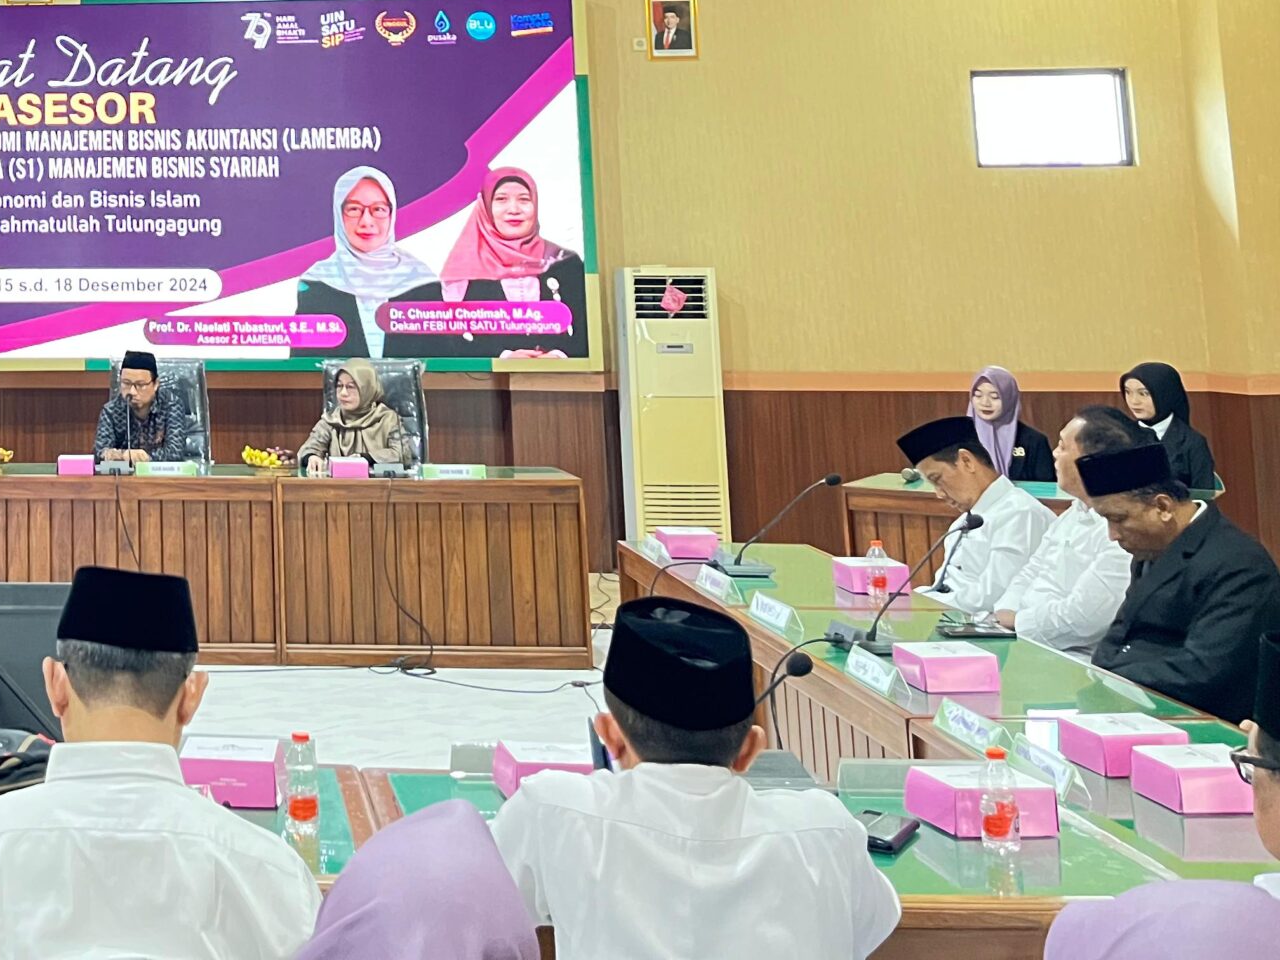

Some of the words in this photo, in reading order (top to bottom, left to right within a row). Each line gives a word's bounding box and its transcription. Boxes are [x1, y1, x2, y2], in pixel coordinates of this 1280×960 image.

[320, 10, 345, 25] UIN
[469, 19, 493, 29] BLU
[321, 19, 356, 37] SATU
[321, 33, 345, 49] SIP
[427, 32, 458, 42] pusaka
[47, 35, 238, 105] Datang
[25, 129, 122, 152] MANAJEMEN
[127, 128, 182, 151] BISNIS
[185, 128, 278, 151] AKUNTANSI
[282, 126, 381, 152] (LAMEMBA)
[8, 157, 45, 182] (S1)
[48, 156, 147, 179] MANAJEMEN
[151, 156, 206, 178] BISNIS
[209, 155, 280, 178] SYARIAH
[51, 190, 85, 208] dan
[89, 190, 145, 208] Bisnis
[150, 190, 201, 208] Islam
[104, 215, 222, 237] Tulungagung
[19, 278, 48, 292] s.d.
[54, 278, 73, 292] 18
[78, 277, 164, 292] Desember
[169, 277, 208, 292] 2024
[389, 308, 406, 319] Dr.
[407, 308, 453, 320] Chusnul
[149, 321, 174, 333] Prof.
[176, 321, 192, 333] Dr.
[389, 321, 421, 331] Dekan
[423, 321, 447, 331] FEBI
[448, 321, 468, 331] UIN
[469, 321, 497, 331] SATU
[499, 321, 561, 333] Tulungagung
[197, 334, 230, 344] Asesor
[231, 334, 238, 344] 2
[239, 334, 291, 344] LAMEMBA
